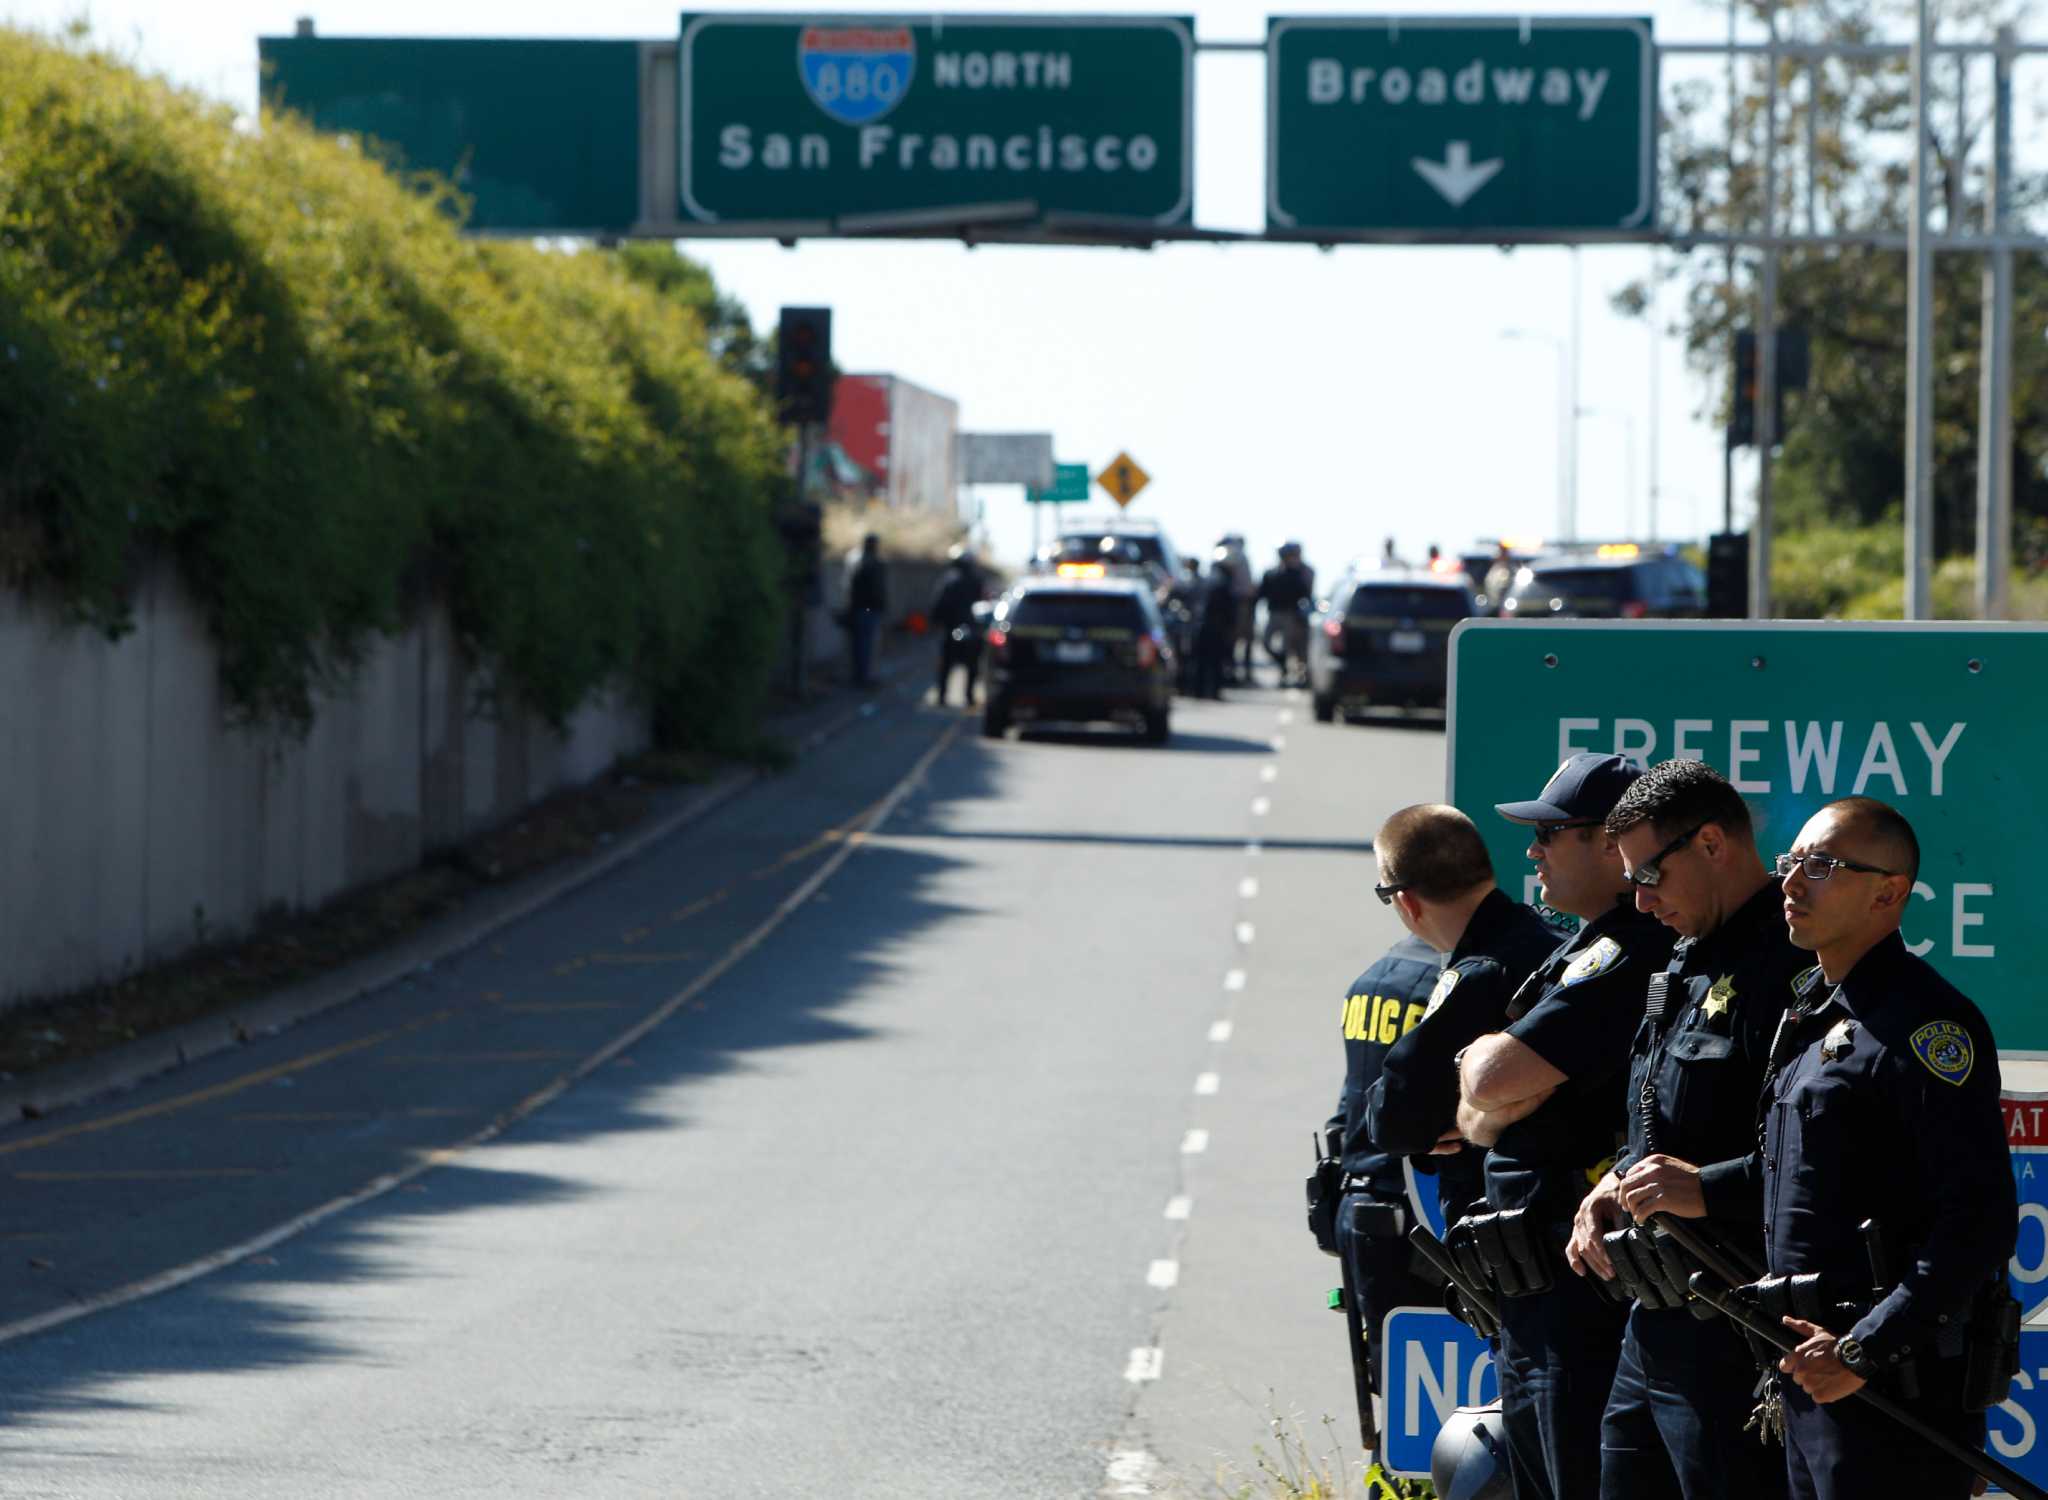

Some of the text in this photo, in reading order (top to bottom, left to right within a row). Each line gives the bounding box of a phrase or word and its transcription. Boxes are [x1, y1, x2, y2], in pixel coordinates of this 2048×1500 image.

[817, 62, 899, 101] 880
[934, 52, 1071, 88] NORTH
[1308, 58, 1609, 120] Broadway
[719, 124, 1158, 170] San Francisco
